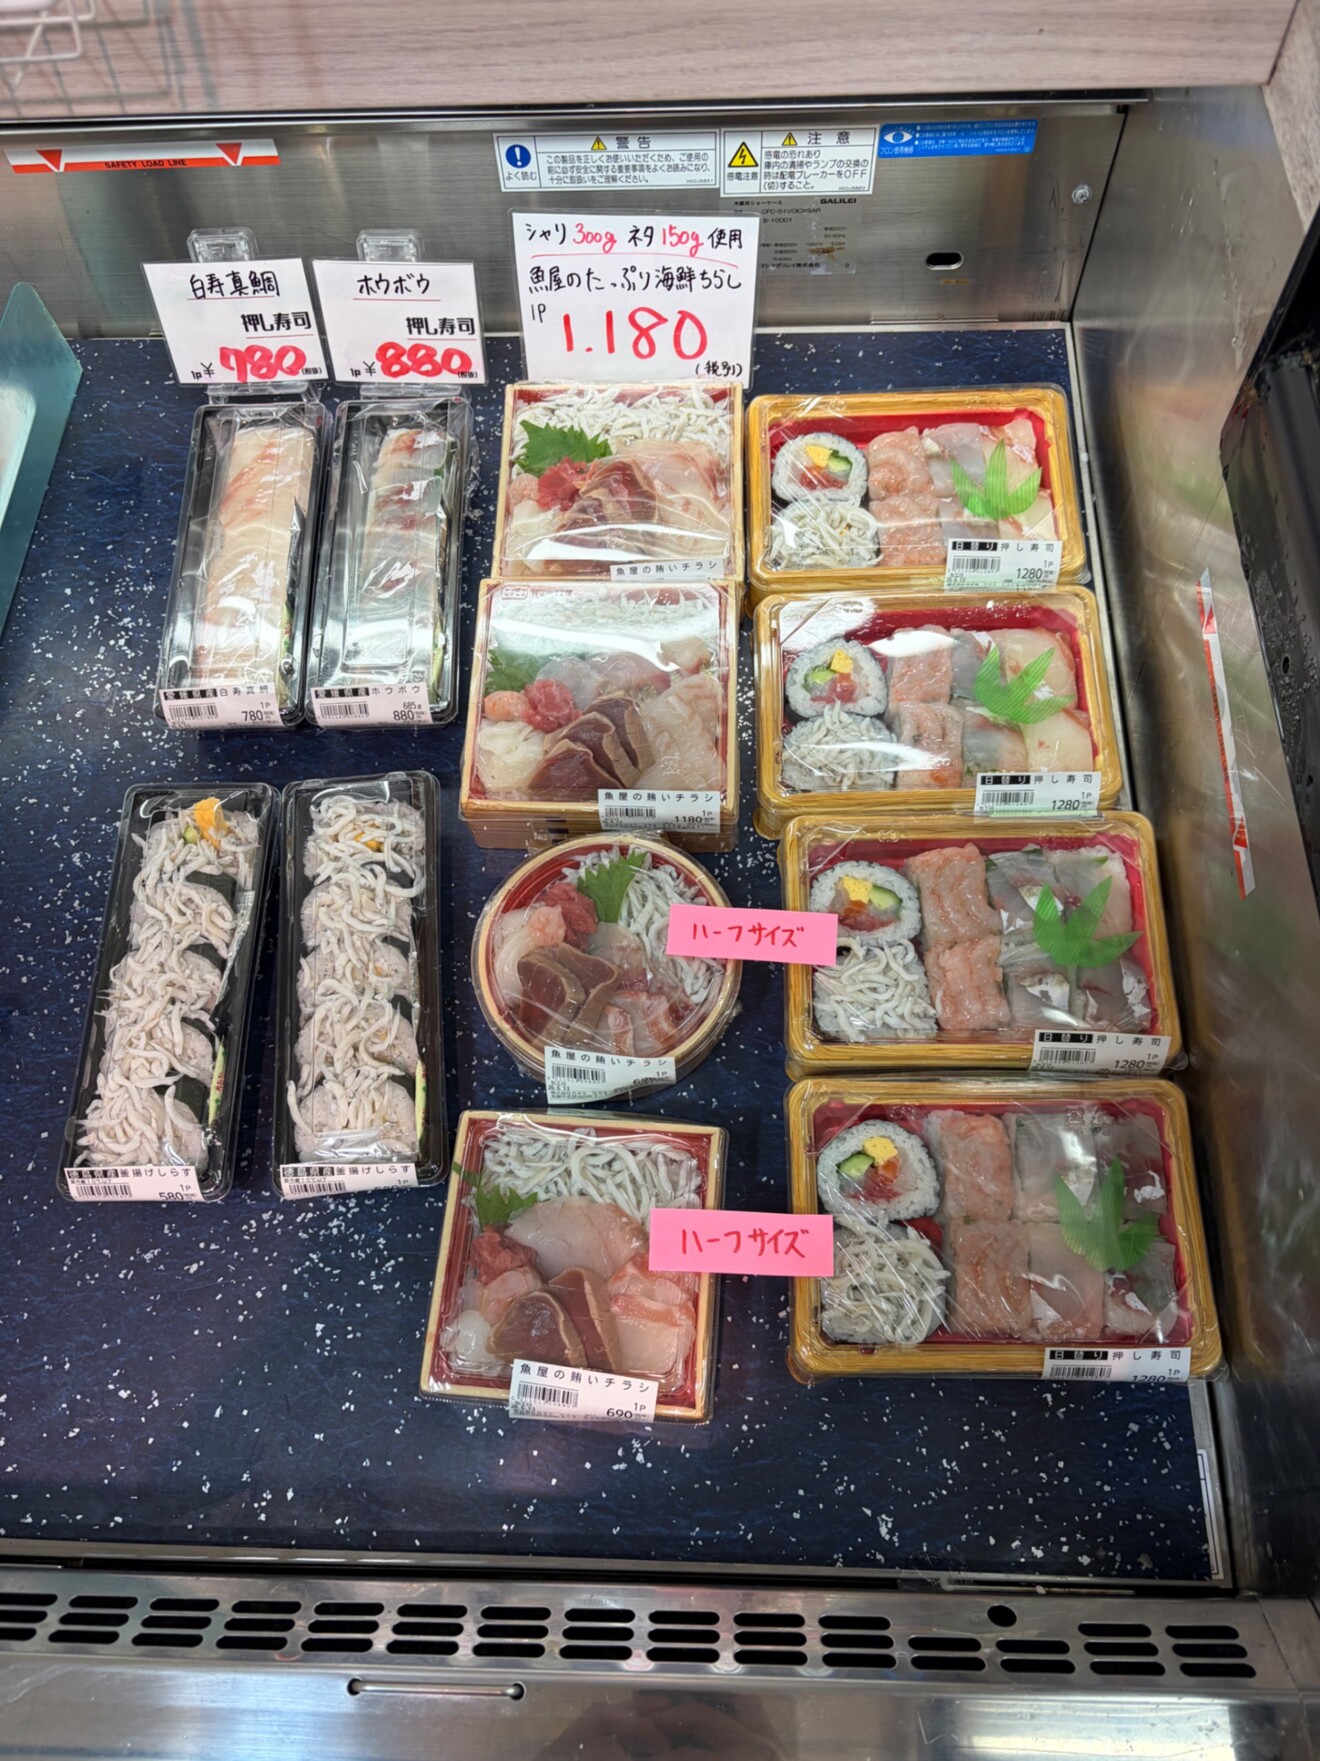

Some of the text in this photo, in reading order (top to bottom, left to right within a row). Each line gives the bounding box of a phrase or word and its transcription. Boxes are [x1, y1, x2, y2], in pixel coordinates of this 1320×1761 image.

[616, 136, 651, 150] 警告
[807, 131, 851, 145] 注意
[764, 149, 821, 159] 感電の恐れあり
[105, 158, 188, 169] SAFETY LOAD LINE
[764, 159, 869, 170] 庫内の清掃やランプの交換の
[505, 171, 538, 182] よく読む
[727, 172, 759, 181] 感電注意
[525, 222, 567, 246] シャリ
[572, 222, 617, 254] 300g
[628, 225, 654, 247] ネタ
[661, 223, 704, 257] 150g
[707, 227, 744, 249] 使用
[190, 270, 280, 299] 白寿真鯛
[357, 273, 431, 295] ホウボウ
[528, 265, 742, 294] 魚屋のたっぷり海鮮ちらし
[241, 311, 312, 333] 押し寿司
[406, 317, 476, 336] 押し寿司
[695, 360, 743, 378] (税別)
[1000, 542, 1055, 553] 押し寿司
[1043, 560, 1054, 568] 1P
[1016, 567, 1044, 580] 1280
[259, 701, 271, 710] 1P
[241, 709, 264, 722] 780
[392, 709, 415, 721] 880
[1033, 774, 1093, 785] 押し寿司
[604, 791, 714, 803] 魚屋の賄いチラシ
[1081, 791, 1092, 799] 1P
[1051, 799, 1080, 811] 1280
[674, 815, 703, 824] 1180
[691, 921, 806, 949] ハーフサイズ
[1096, 1034, 1162, 1047] 押し寿司
[551, 1049, 668, 1067] 魚屋の賄いチラシ
[1114, 1059, 1146, 1069] 1280
[120, 1167, 191, 1178] 釜揚げしらす
[335, 1164, 411, 1176] 釜揚げしらす
[180, 1184, 192, 1192] 1P
[158, 1191, 184, 1201] 580
[681, 1227, 810, 1259] ハーフサイズ
[1111, 1350, 1182, 1361] 押し寿司
[519, 1362, 650, 1393] 魚屋の賄いチラシ
[1167, 1368, 1181, 1376] 1P
[606, 1407, 633, 1419] 690
[633, 1402, 647, 1412] 1P
